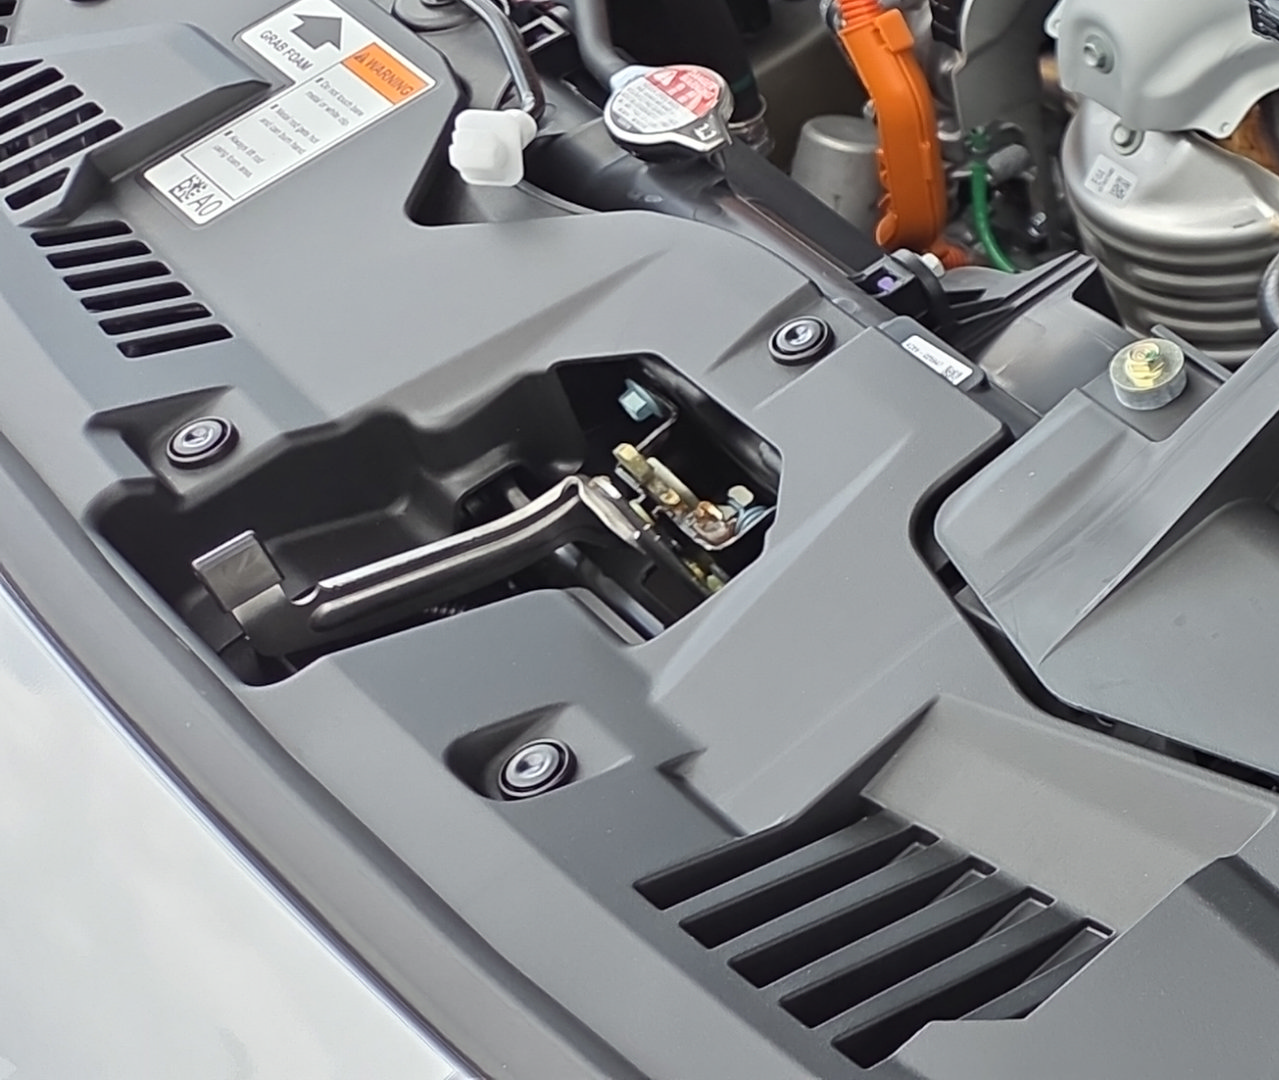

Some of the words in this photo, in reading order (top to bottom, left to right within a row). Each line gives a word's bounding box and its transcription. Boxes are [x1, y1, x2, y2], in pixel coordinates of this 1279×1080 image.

[259, 30, 286, 51] GRAB
[282, 48, 314, 72] FOAM
[366, 57, 414, 97] WARNING
